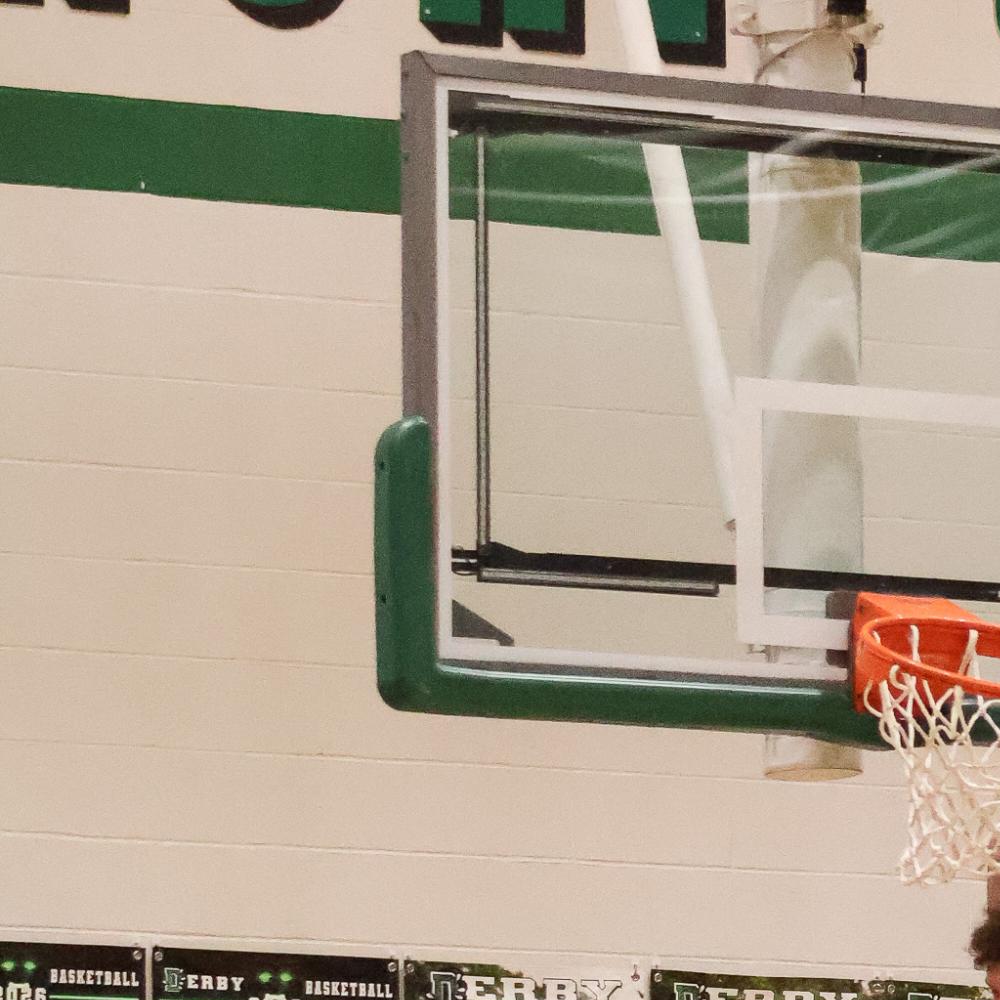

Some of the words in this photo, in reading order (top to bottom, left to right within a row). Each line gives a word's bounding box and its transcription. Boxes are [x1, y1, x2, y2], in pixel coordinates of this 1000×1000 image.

[50, 969, 139, 987] BASKETBALL
[162, 968, 244, 992] DERBY
[305, 981, 394, 998] BASKETBALL
